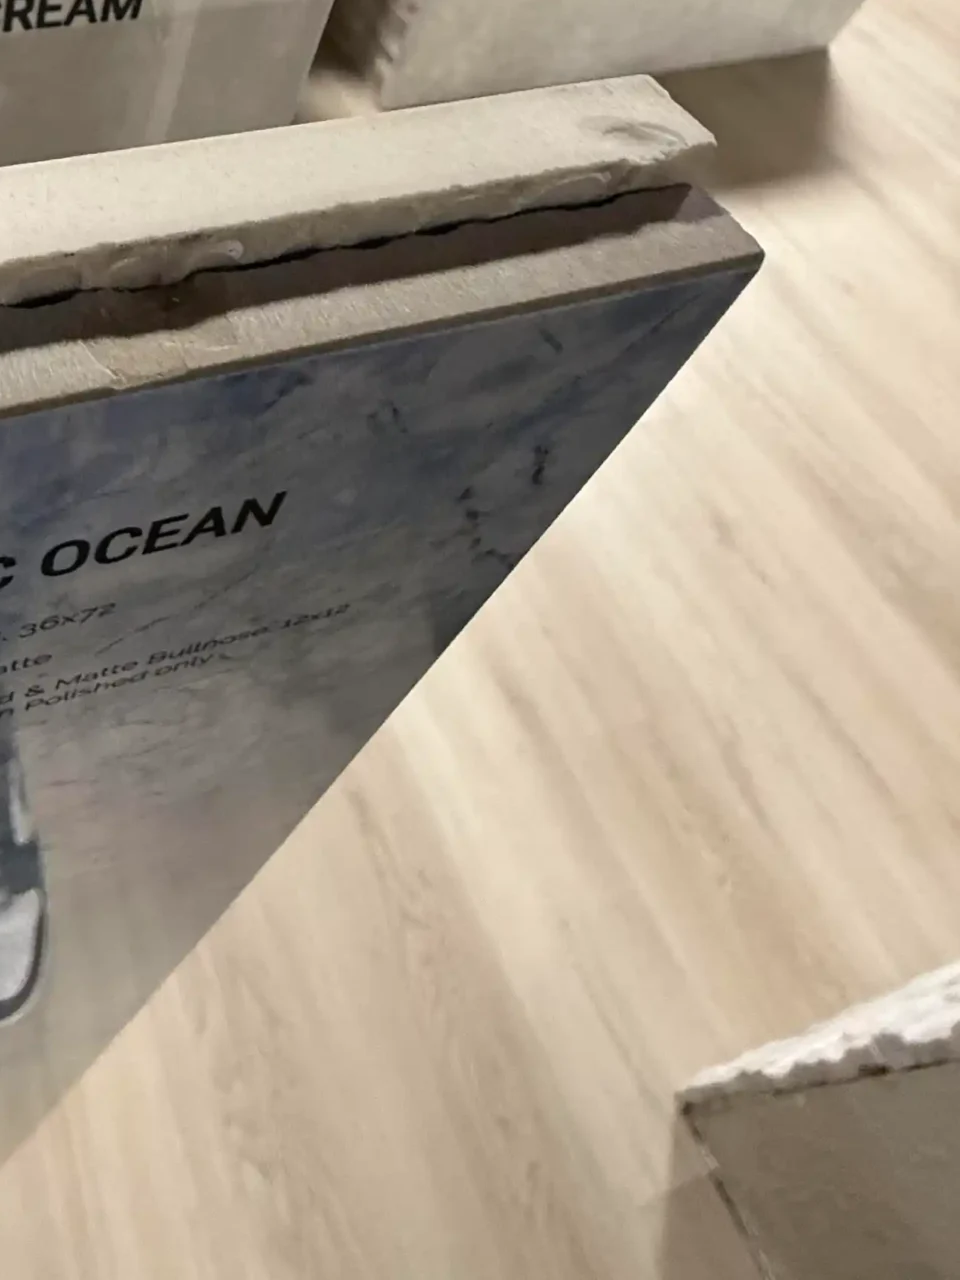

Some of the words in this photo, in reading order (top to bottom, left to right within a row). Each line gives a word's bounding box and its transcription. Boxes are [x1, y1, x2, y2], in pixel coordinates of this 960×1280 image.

[41, 490, 287, 577] OCEAN
[19, 602, 116, 639] 36x72
[25, 670, 148, 712] Polished
[55, 659, 139, 691] Matte
